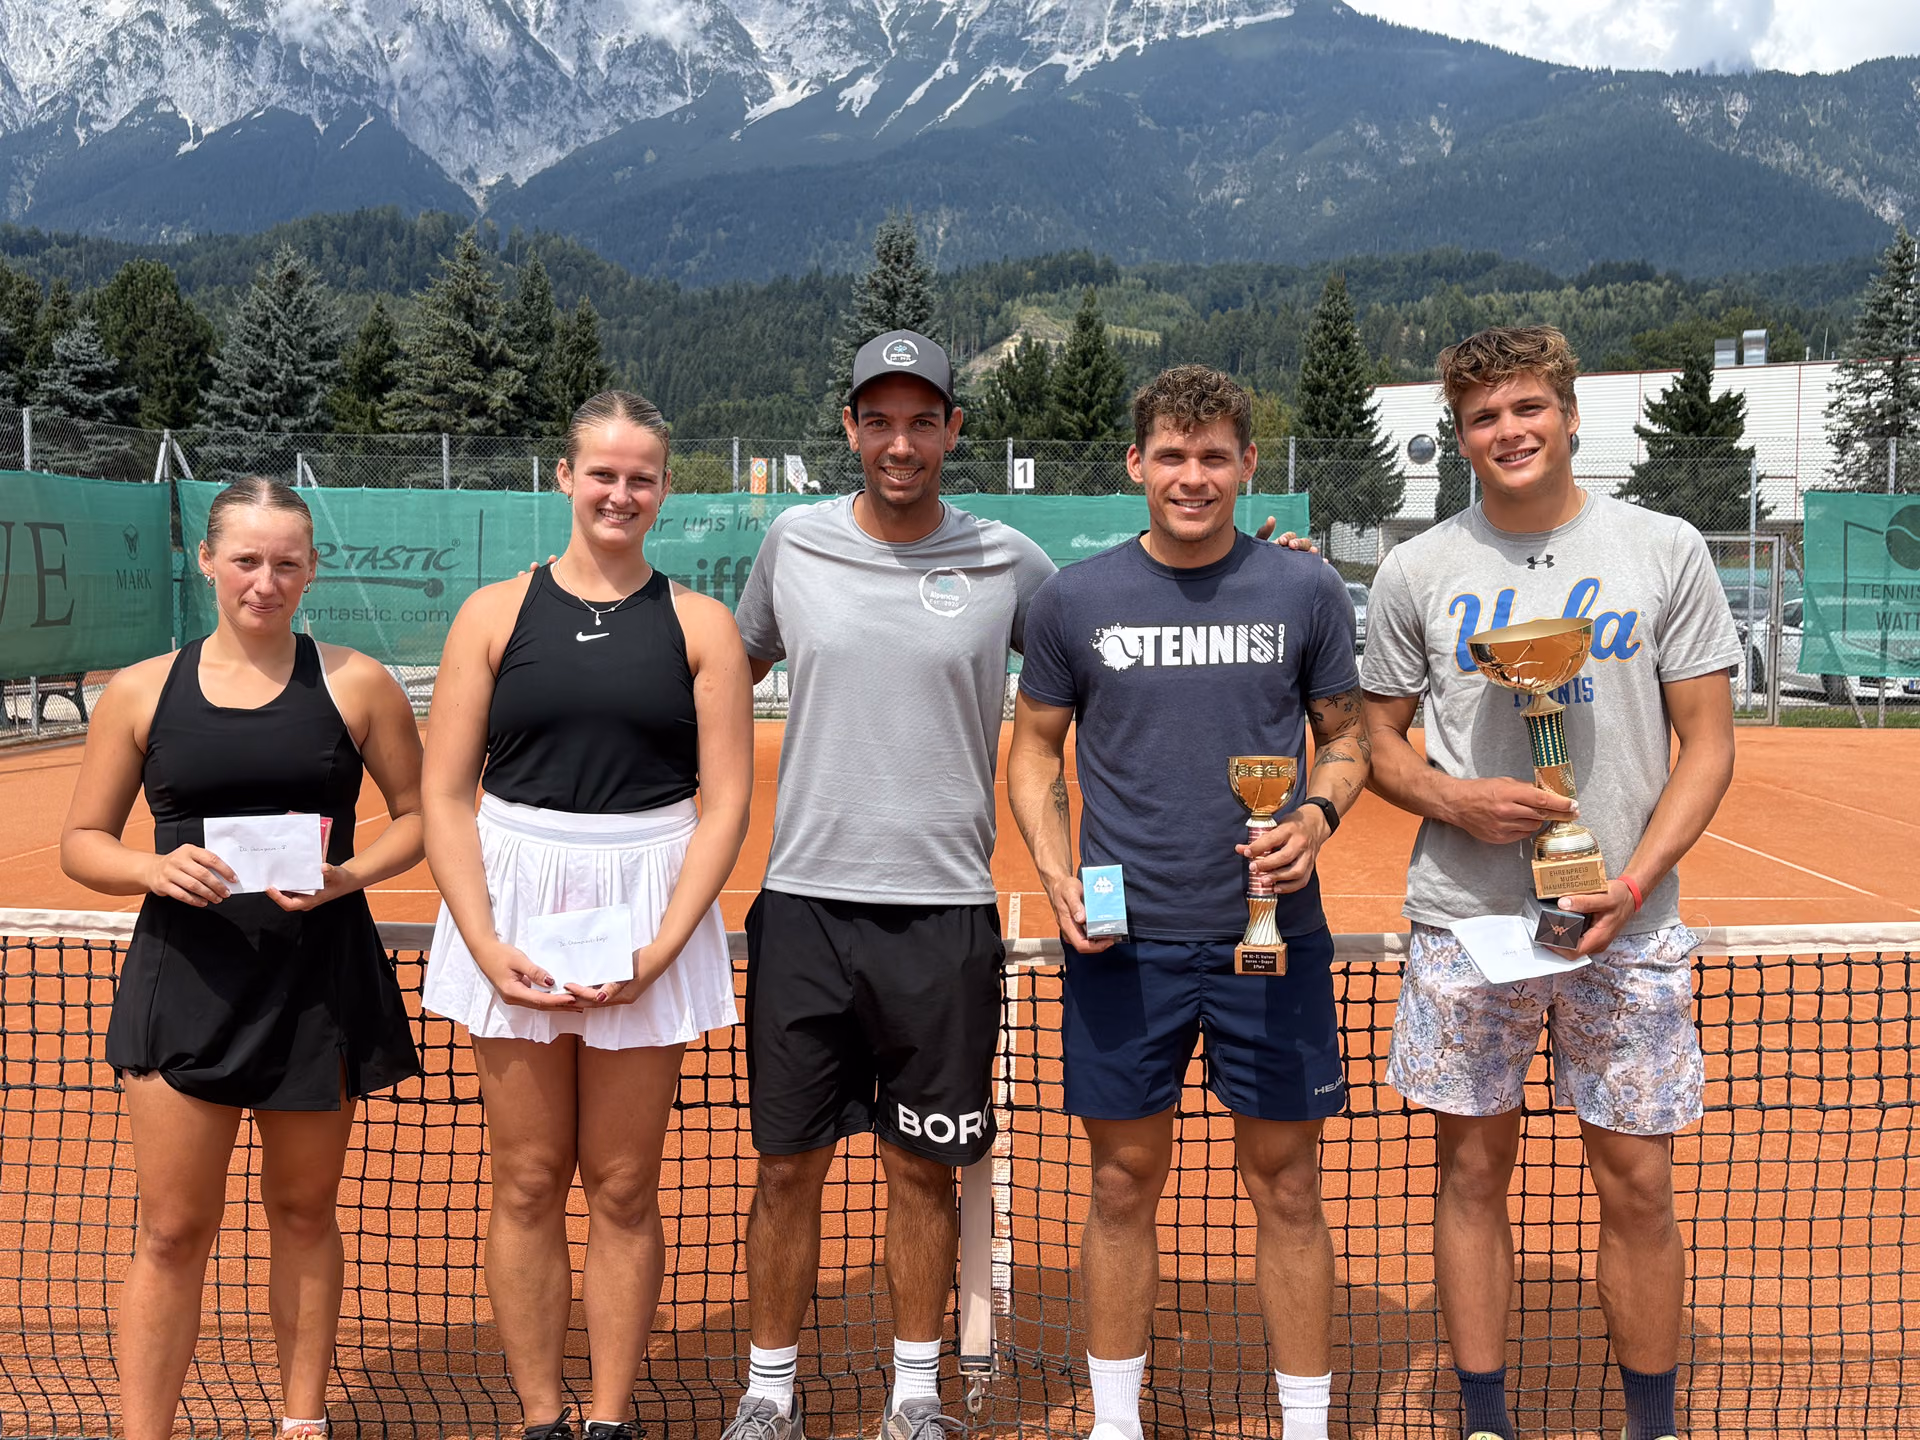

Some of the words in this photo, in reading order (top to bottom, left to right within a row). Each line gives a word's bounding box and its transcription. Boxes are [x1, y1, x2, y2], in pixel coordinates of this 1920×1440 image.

[1017, 460, 1028, 484] 1
[683, 514, 726, 532] uns
[737, 511, 758, 532] in
[115, 568, 152, 590] MARK
[1448, 576, 1642, 674] Ula
[1136, 623, 1275, 667] TENNIS
[1277, 623, 1285, 664] HEAD
[1549, 866, 1589, 878] EHRENPREIS
[1560, 874, 1581, 882] MUSIK
[1543, 878, 1600, 891] HAMMERSCHMIDT
